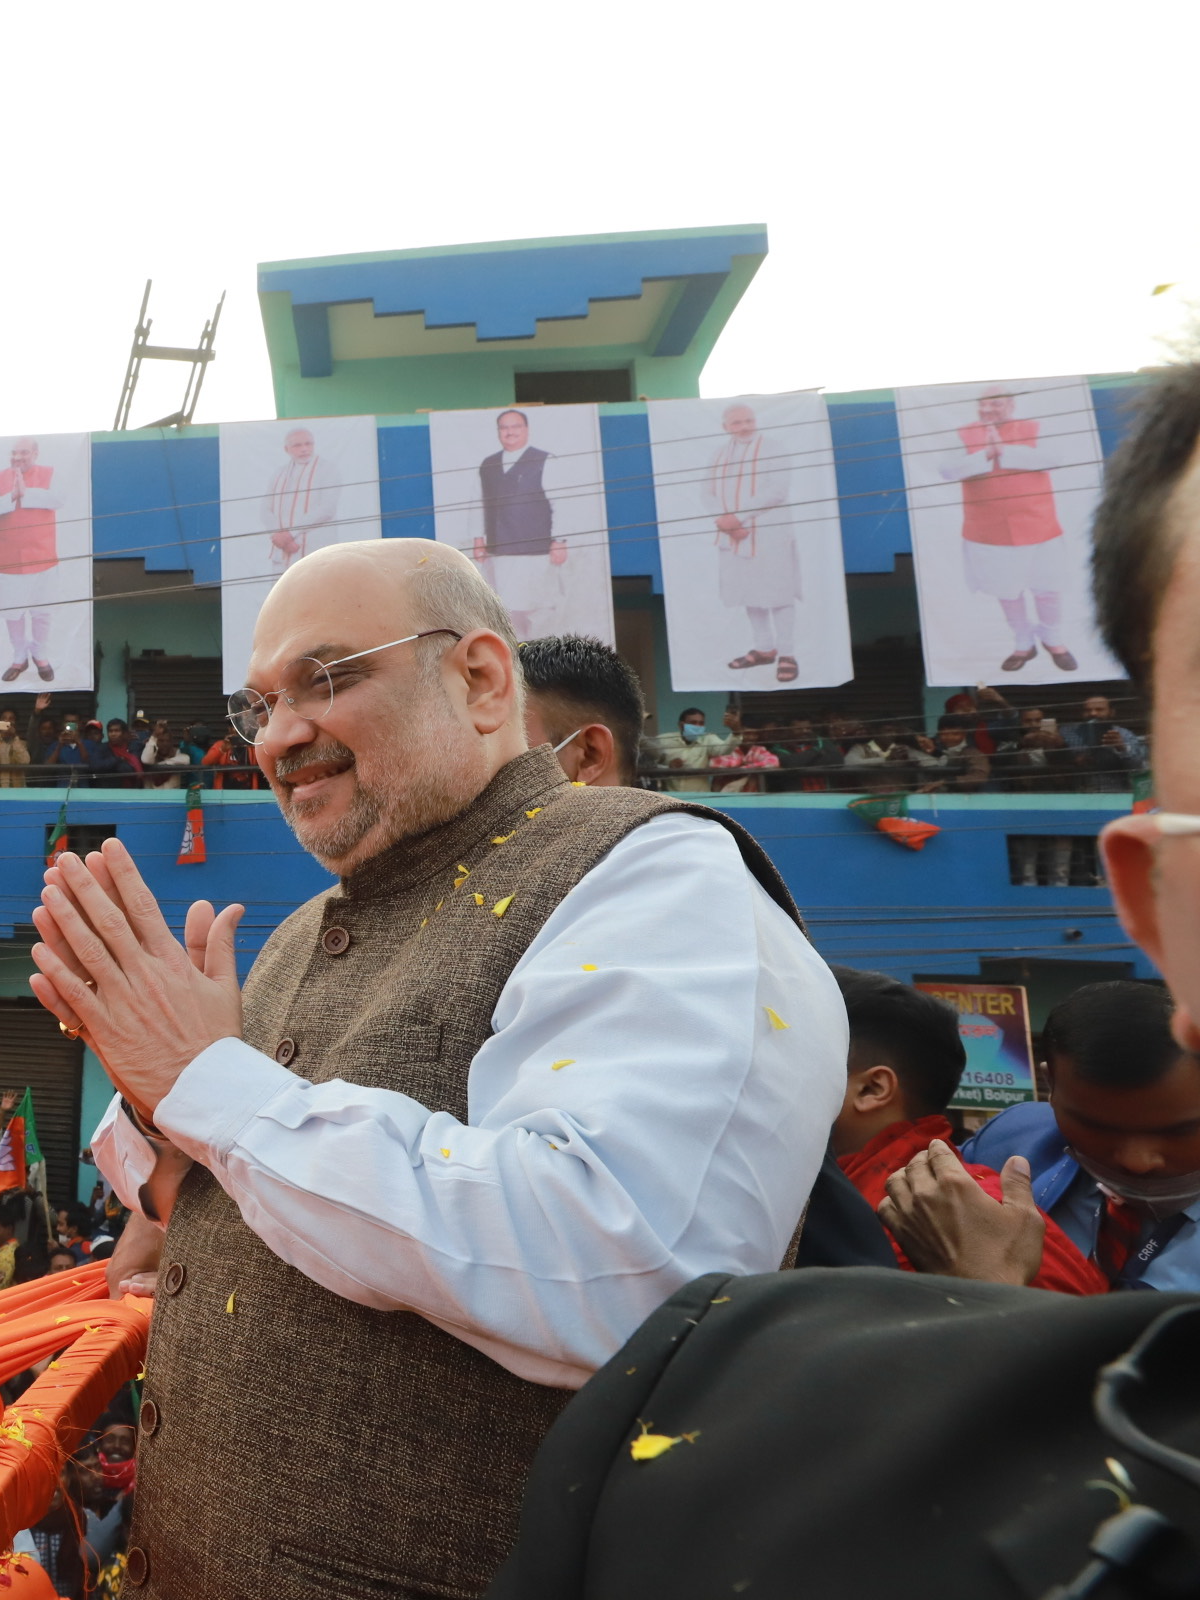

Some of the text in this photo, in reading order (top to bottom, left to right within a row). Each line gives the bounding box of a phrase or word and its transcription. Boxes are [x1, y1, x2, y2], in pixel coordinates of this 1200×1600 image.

[960, 1071, 1015, 1085] 16408
[984, 1088, 1026, 1104] Bolpur
[1138, 1239, 1159, 1261] CRPF
